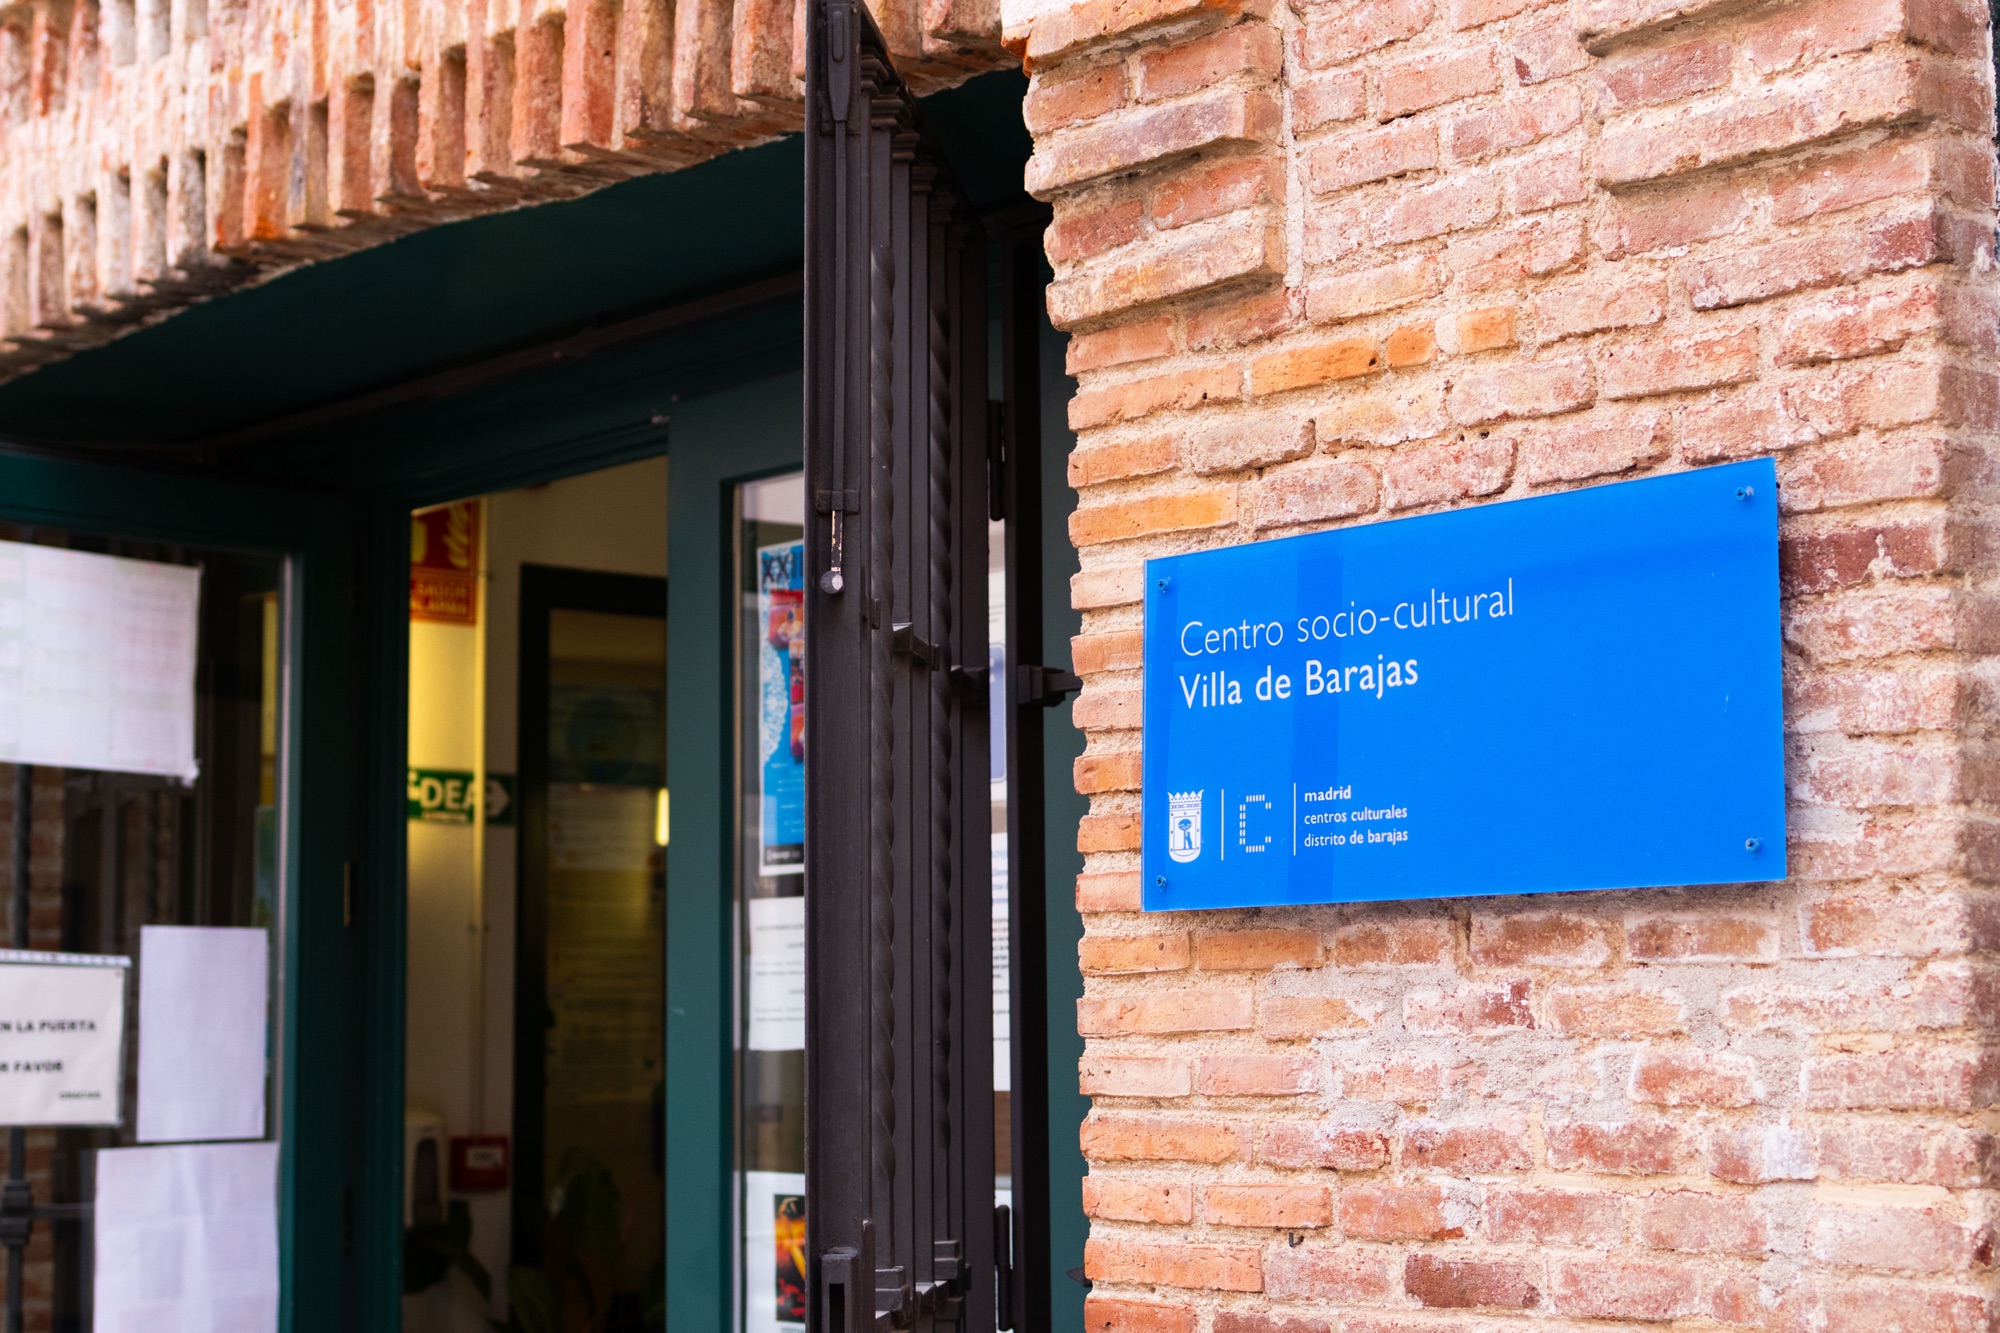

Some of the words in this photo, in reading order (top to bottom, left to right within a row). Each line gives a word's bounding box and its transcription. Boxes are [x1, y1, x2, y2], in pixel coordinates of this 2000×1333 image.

[1180, 619, 1283, 656] Centro
[1297, 577, 1513, 642] socio-cultural
[1179, 671, 1242, 709] Villa
[1255, 664, 1291, 701] de
[1305, 653, 1418, 700] Barajas
[1304, 785, 1352, 802] madrid
[1304, 811, 1347, 825] centros
[1351, 804, 1408, 822] culturales
[1304, 832, 1346, 847] distrito
[1350, 829, 1364, 845] de
[1367, 828, 1409, 846] barajas
[16, 1021, 34, 1032] LA
[39, 1020, 96, 1032] PUERTA
[14, 1060, 63, 1072] FAVOR
